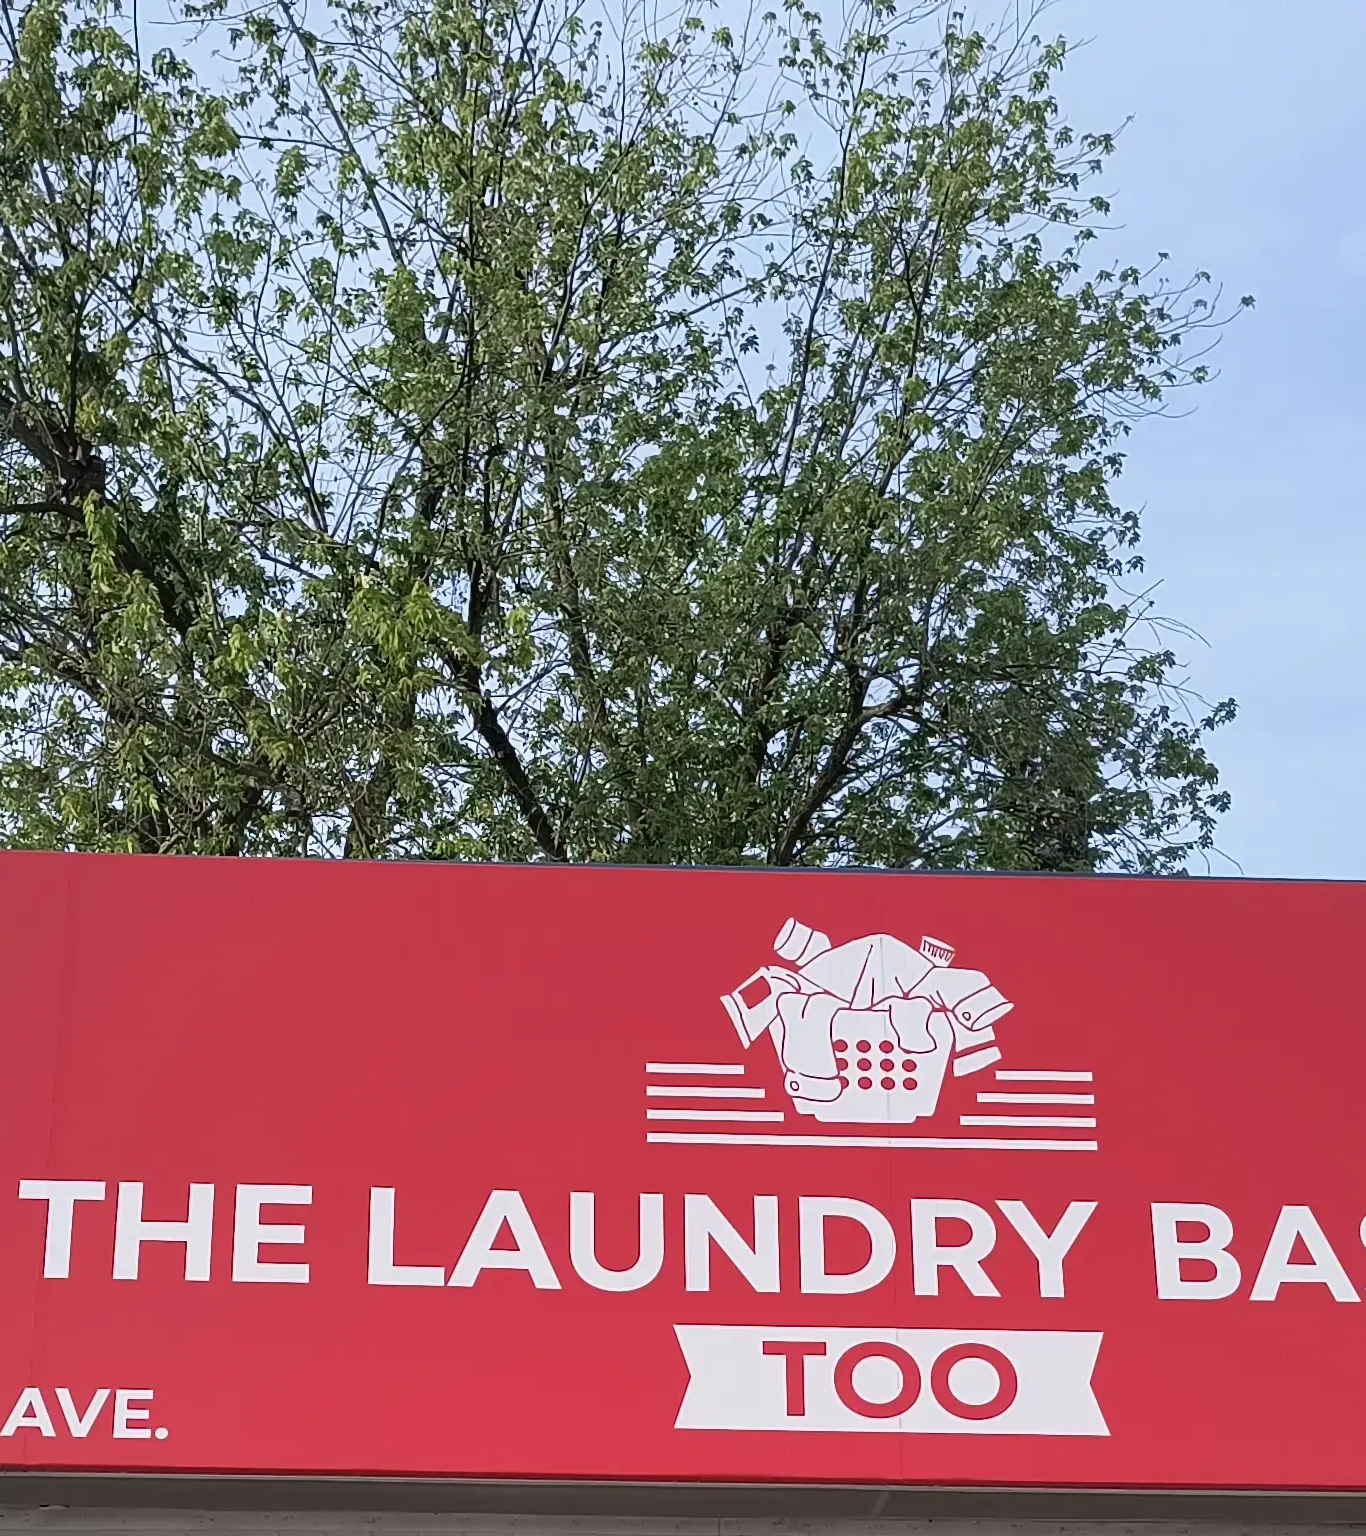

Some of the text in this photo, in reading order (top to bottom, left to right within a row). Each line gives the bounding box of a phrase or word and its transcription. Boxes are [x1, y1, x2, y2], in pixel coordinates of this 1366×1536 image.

[18, 1179, 313, 1284] THE
[368, 1186, 1098, 1299] LAUNDRY
[0, 1387, 170, 1441] AVE.
[762, 1339, 1018, 1420] TOO
